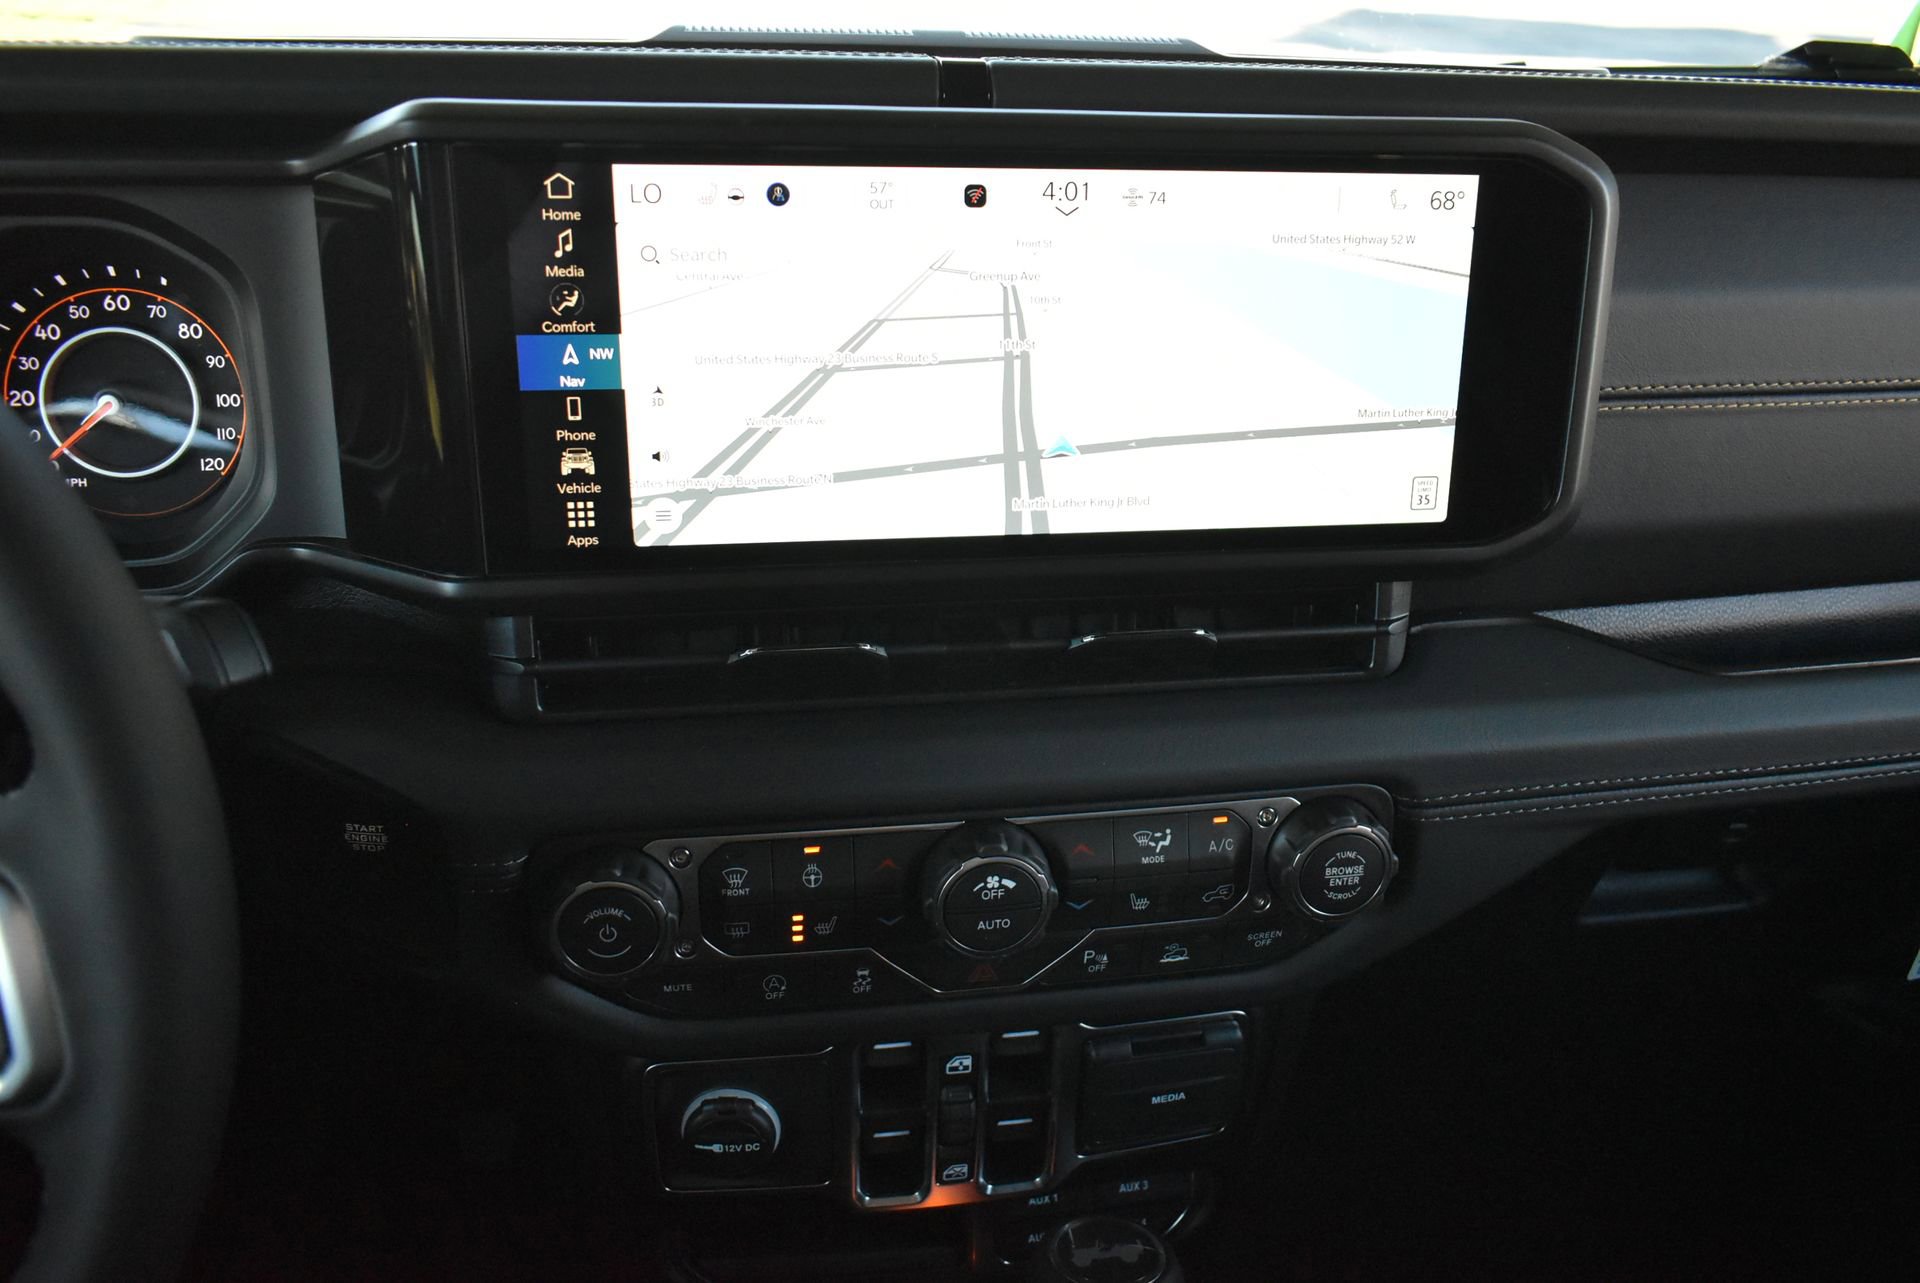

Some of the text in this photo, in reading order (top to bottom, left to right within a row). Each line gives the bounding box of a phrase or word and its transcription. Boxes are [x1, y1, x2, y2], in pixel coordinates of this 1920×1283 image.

[630, 182, 662, 204] LO
[1042, 181, 1089, 202] 4:01
[1149, 191, 1166, 205] 74
[869, 199, 894, 209] OUT
[542, 208, 582, 221] Home
[1272, 233, 1416, 247] United States Highway 52 W
[669, 247, 729, 262] Search
[545, 265, 585, 277] Media
[969, 270, 1041, 284] Greenup Ave
[103, 294, 131, 311] 60
[68, 305, 90, 319] 50
[147, 305, 167, 319] 70
[34, 324, 61, 340] 40
[178, 323, 203, 339] 80
[542, 321, 596, 333] Comfort
[589, 347, 614, 360] NW
[695, 354, 734, 366] United
[736, 354, 772, 366] States
[774, 353, 824, 368] Highway
[845, 351, 894, 364] Business
[896, 351, 930, 363] Route
[18, 356, 40, 371] 30
[205, 355, 226, 369] 90
[560, 376, 585, 388] Nav
[9, 390, 36, 407] 20
[215, 393, 241, 408] 100
[650, 398, 665, 408] 3D
[1357, 408, 1391, 419] Martin
[1393, 408, 1425, 418] Luther
[1426, 407, 1449, 419] King
[744, 416, 826, 427] Winchester Ave
[216, 427, 237, 441] 110
[556, 430, 596, 442] Phone
[200, 457, 225, 472] 120
[556, 482, 602, 494] Vehicle
[666, 477, 716, 491] Highway
[736, 475, 786, 487] Business
[787, 474, 821, 485] Route
[1013, 498, 1049, 510] Martin
[1052, 497, 1087, 509] Luther
[1090, 497, 1116, 511] King
[1126, 496, 1151, 507] Blvd
[1416, 494, 1431, 506] 35
[567, 535, 600, 548] Apps
[345, 823, 385, 833] START
[344, 832, 390, 843] ENGINE
[352, 843, 385, 853] STOP
[1208, 838, 1234, 853] A/C
[1141, 855, 1166, 865] MODE
[1335, 850, 1359, 860] TUNE
[1325, 864, 1366, 876] BROWSE
[1329, 876, 1360, 887] ENTER
[721, 888, 751, 897] FRONT
[981, 888, 1006, 901] OFF
[1327, 889, 1358, 901] SCROLL
[585, 907, 625, 920] VOLUME
[977, 918, 1011, 930] AUTO
[1247, 928, 1284, 942] SCREEN
[1254, 938, 1274, 948] OFF
[1088, 964, 1108, 974] OFF
[664, 984, 693, 993] MUTE
[853, 985, 873, 994] OFF
[765, 991, 785, 1000] OFF
[1151, 1091, 1187, 1105] MEDIA
[725, 1142, 761, 1153] 12V DC
[1118, 1179, 1150, 1193] AUX 3
[1028, 1195, 1051, 1206] AUX
